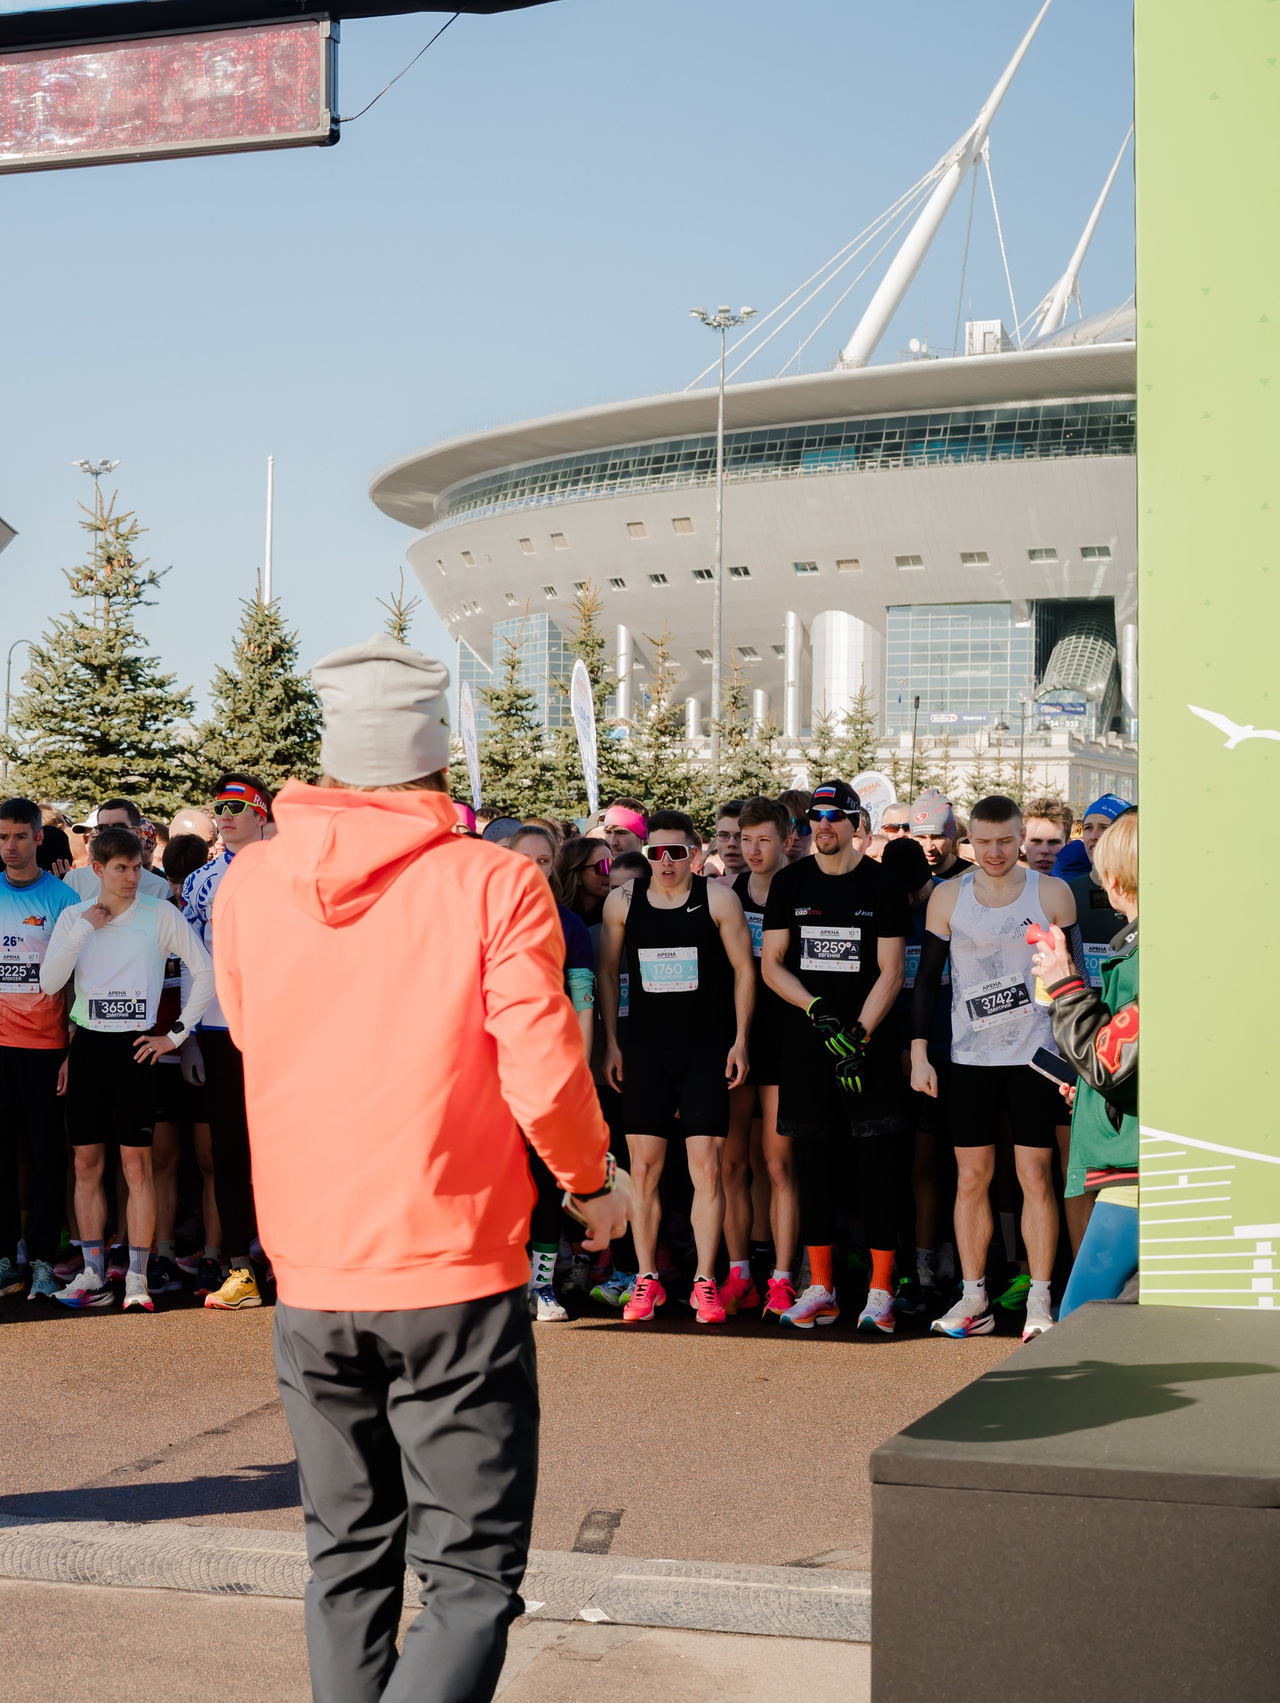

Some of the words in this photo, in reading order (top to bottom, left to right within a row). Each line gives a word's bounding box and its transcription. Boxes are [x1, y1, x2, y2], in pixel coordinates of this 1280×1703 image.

[858, 781, 880, 796] РЕНА
[751, 927, 764, 940] 10
[813, 941, 846, 953] 3259
[653, 963, 683, 975] 1760
[981, 990, 1014, 1010] 3742
[101, 1001, 134, 1013] 3650
